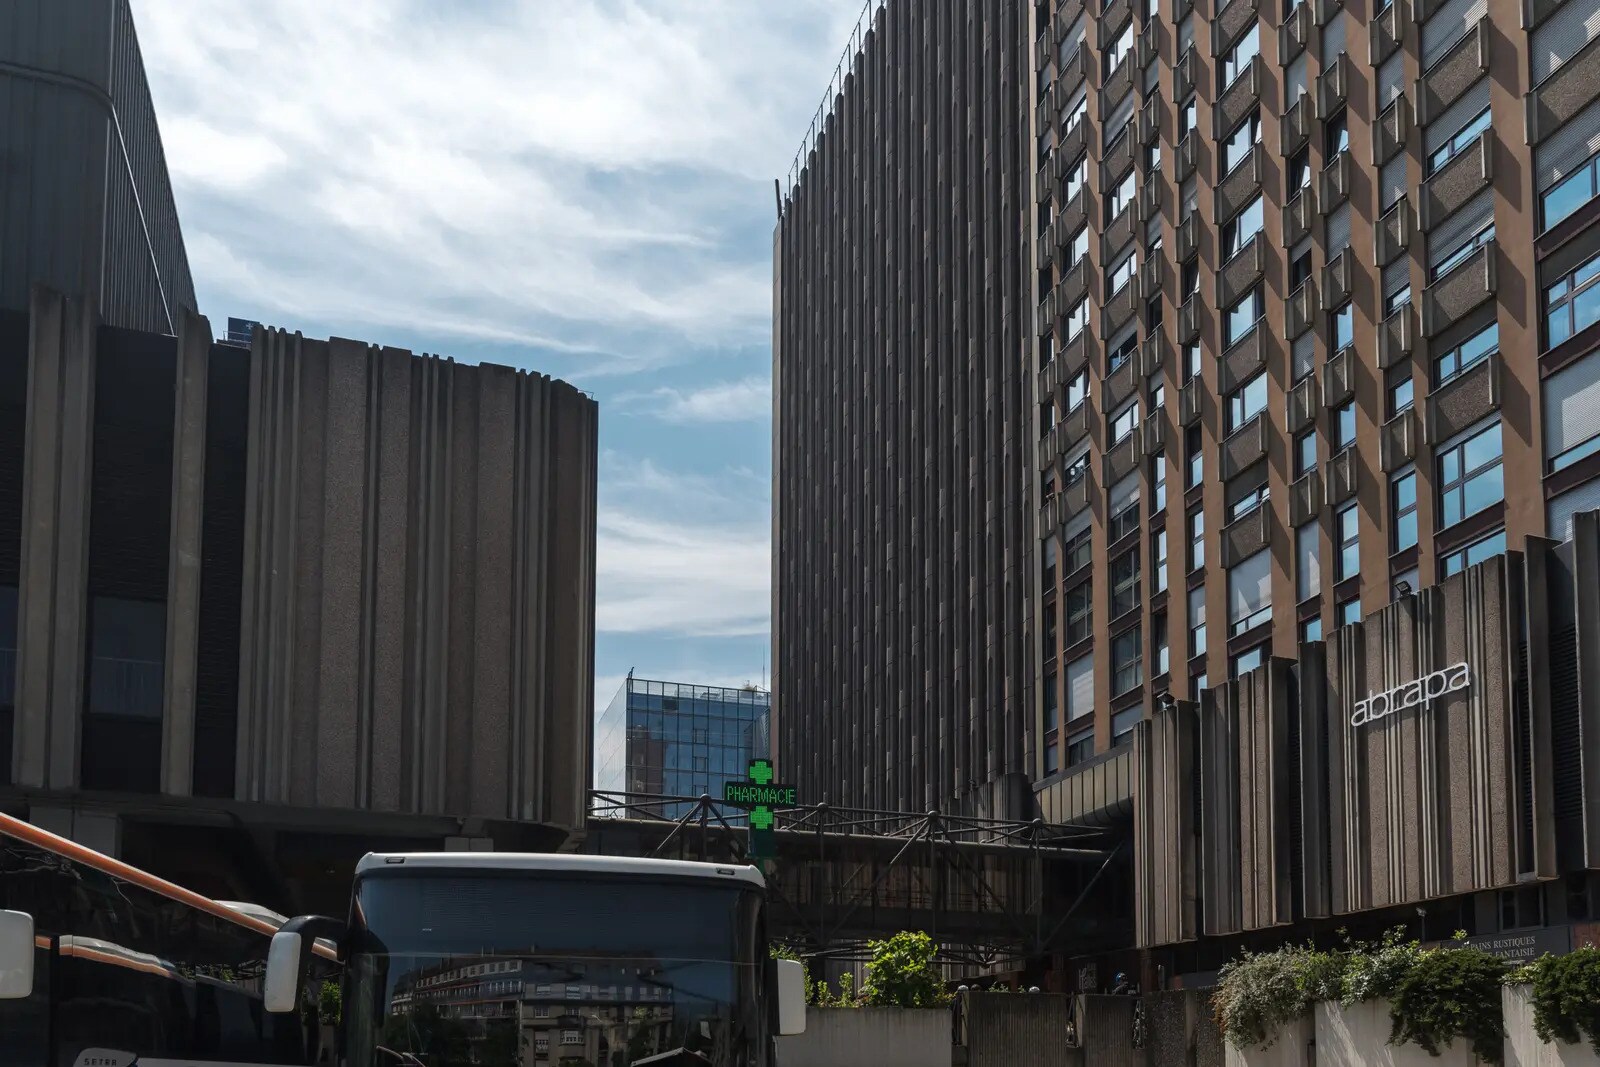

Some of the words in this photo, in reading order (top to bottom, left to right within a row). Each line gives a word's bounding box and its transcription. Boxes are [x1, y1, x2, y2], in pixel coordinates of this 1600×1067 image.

[1351, 661, 1470, 727] abrapa
[727, 785, 795, 804] PHARMACIE
[1470, 941, 1491, 951] PAINS
[1493, 936, 1535, 948] RUSTIQUES
[1495, 947, 1535, 958] FANTAISIE
[84, 1058, 116, 1066] SETRA
